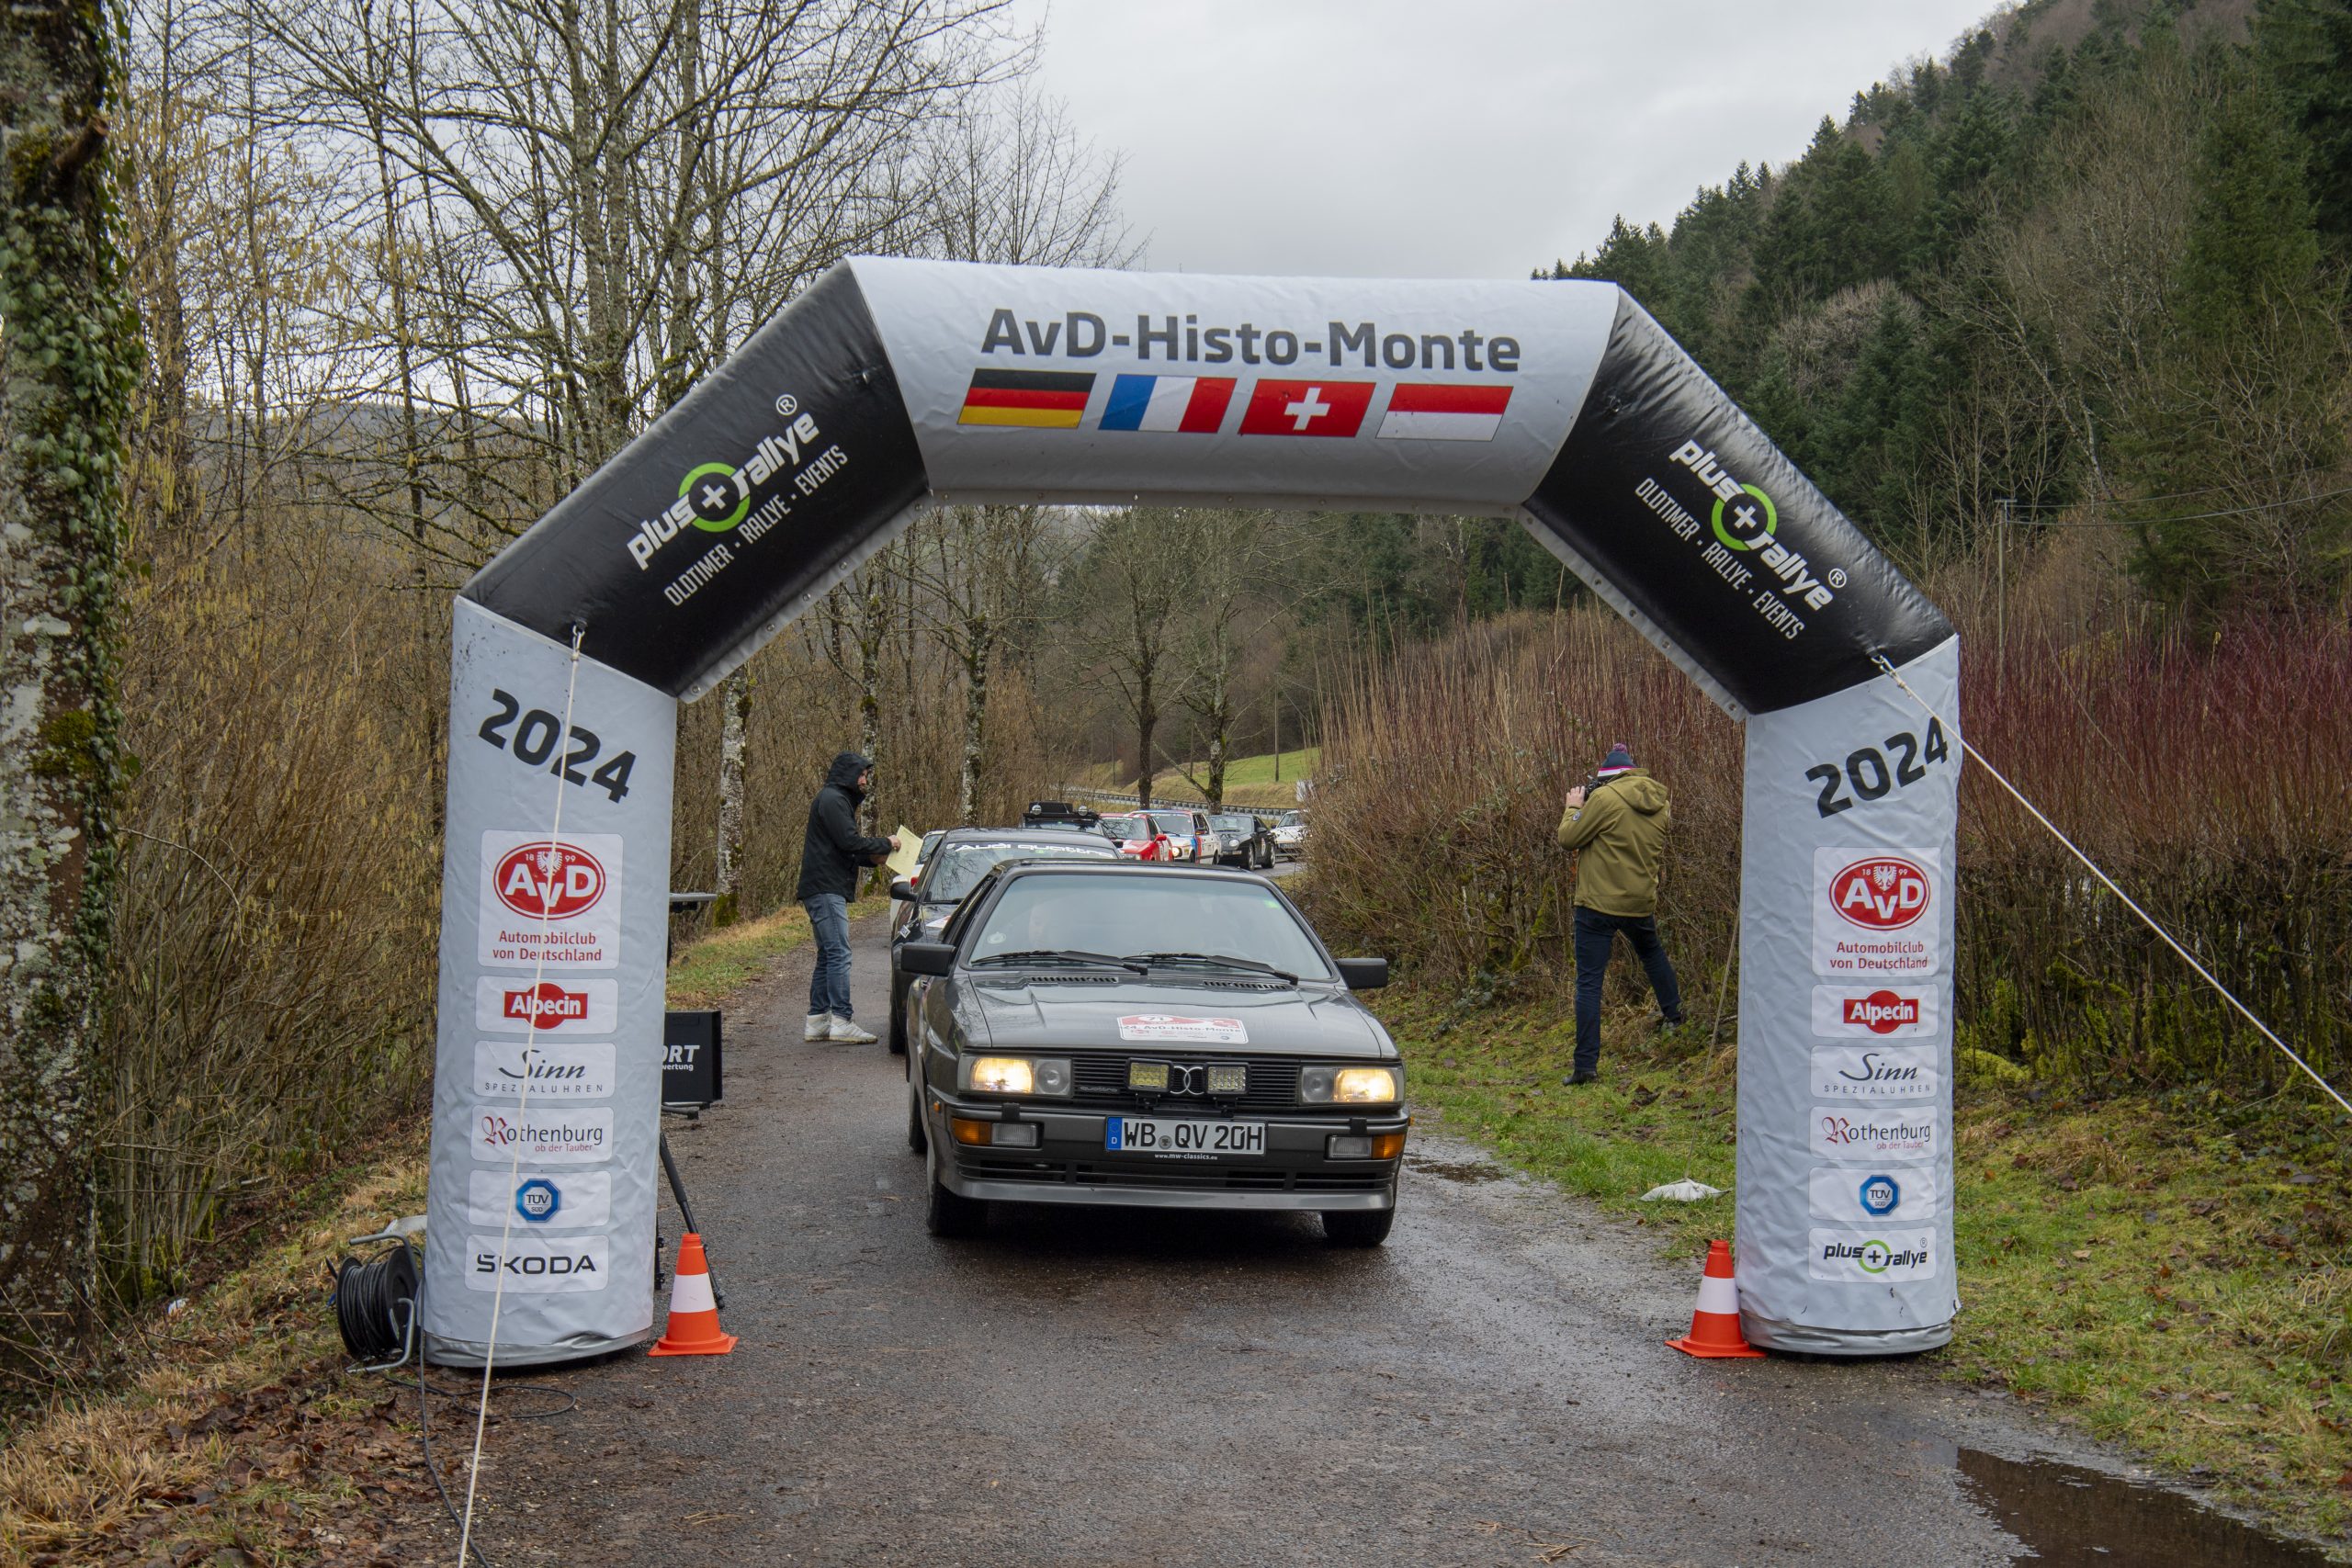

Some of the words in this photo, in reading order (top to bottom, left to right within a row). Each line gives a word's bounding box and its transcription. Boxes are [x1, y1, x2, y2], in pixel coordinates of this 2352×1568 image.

[981, 309, 1520, 372] AvD-Histo-Monte
[663, 544, 734, 606] OLDTIMER
[738, 494, 791, 544] RALLYE
[794, 445, 848, 496] EVENTS
[1634, 478, 1701, 541] OLDTIMER
[1702, 541, 1752, 591] RALLYE
[1752, 590, 1805, 639] EVENTS
[479, 688, 636, 804] 2024
[1804, 716, 1948, 818] 2024
[499, 931, 596, 944] Automobilclub
[1837, 942, 1924, 953] Automobilclub
[492, 949, 514, 959] von
[520, 948, 602, 961] Deutschland
[1830, 959, 1853, 968] von
[1858, 956, 1928, 969] Deutschland
[510, 995, 581, 1019] Alpecin
[1849, 1000, 1914, 1026] Alpecin
[498, 1049, 585, 1079] Sinn
[1838, 1053, 1917, 1081] Sinn
[485, 1082, 603, 1093] SPEZIALUHREN
[1825, 1085, 1930, 1094] SPEZIALUHREN
[481, 1116, 603, 1146] Rothenburg
[1124, 1122, 1156, 1147] WB
[1175, 1124, 1208, 1149] QV
[1214, 1125, 1262, 1150] 20H
[1822, 1117, 1930, 1145] Rothenburg
[535, 1144, 546, 1152] ob
[548, 1144, 562, 1152] der
[566, 1143, 593, 1152] Tauber
[1154, 1153, 1218, 1161] www.mw-classics.eu
[1876, 1141, 1887, 1150] ob
[1889, 1142, 1901, 1150] der
[1903, 1140, 1924, 1149] Tauber
